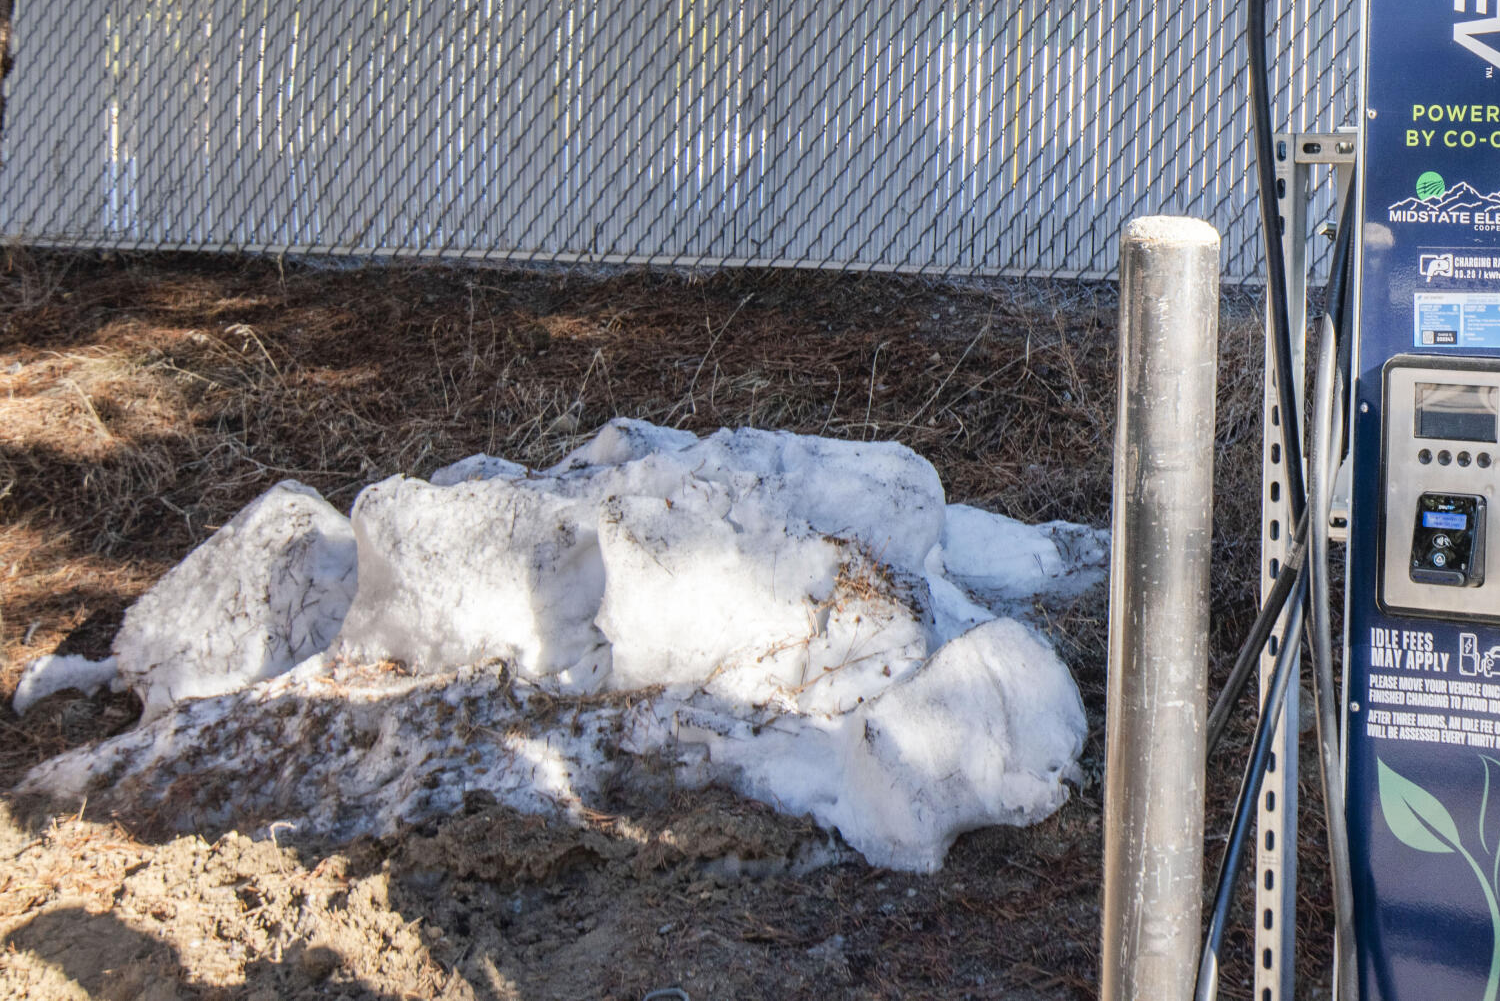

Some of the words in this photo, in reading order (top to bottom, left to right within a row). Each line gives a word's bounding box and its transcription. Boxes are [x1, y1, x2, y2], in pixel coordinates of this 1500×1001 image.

[1406, 129, 1435, 147] BY
[1389, 210, 1470, 224] MIDSTATE
[1454, 256, 1491, 268] CHARGING
[1483, 271, 1500, 279] kWh
[1370, 627, 1399, 649] IDLE
[1402, 630, 1434, 652] FEES
[1371, 647, 1402, 669] MAY
[1406, 650, 1450, 672] APPLY
[1369, 673, 1398, 690] PLEASE
[1398, 676, 1423, 691] MOVE
[1424, 678, 1447, 693] YOUR
[1448, 680, 1481, 697] VEHICLE
[1369, 688, 1405, 705] FINISHED
[1406, 691, 1449, 708] CHARGING
[1450, 695, 1461, 709] TO
[1461, 696, 1488, 712] AVOID
[1367, 709, 1392, 725] AFTER
[1392, 711, 1417, 726] THREE
[1417, 713, 1448, 730] HOURS,
[1448, 715, 1461, 730] AN
[1461, 717, 1479, 732] IDLE
[1480, 719, 1494, 734] FEE
[1366, 722, 1387, 739] WILL
[1387, 725, 1399, 739] BE
[1399, 726, 1440, 743] ASSESSED
[1440, 729, 1467, 745] EVERY
[1467, 732, 1495, 749] THIRTY
